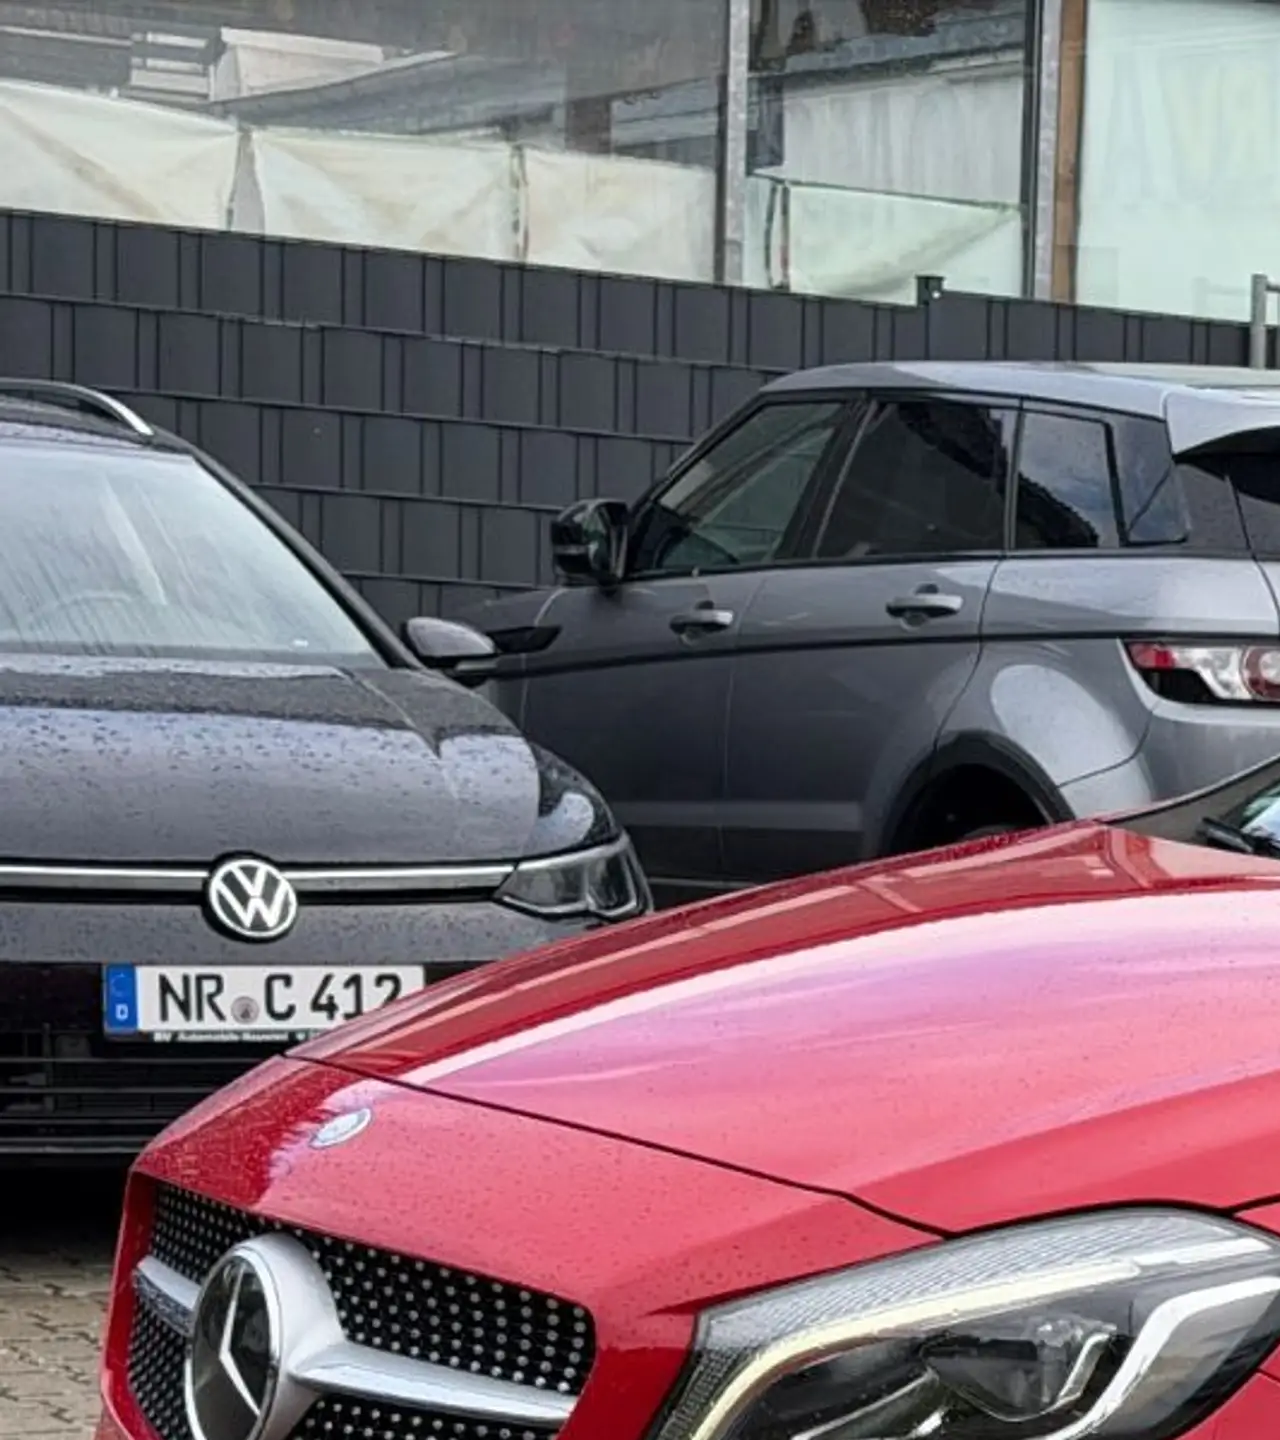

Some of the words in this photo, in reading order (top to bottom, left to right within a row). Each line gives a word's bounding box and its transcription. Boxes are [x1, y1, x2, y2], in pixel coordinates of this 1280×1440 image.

[158, 973, 227, 1022] NR
[264, 973, 297, 1021] C
[310, 973, 402, 1021] 412
